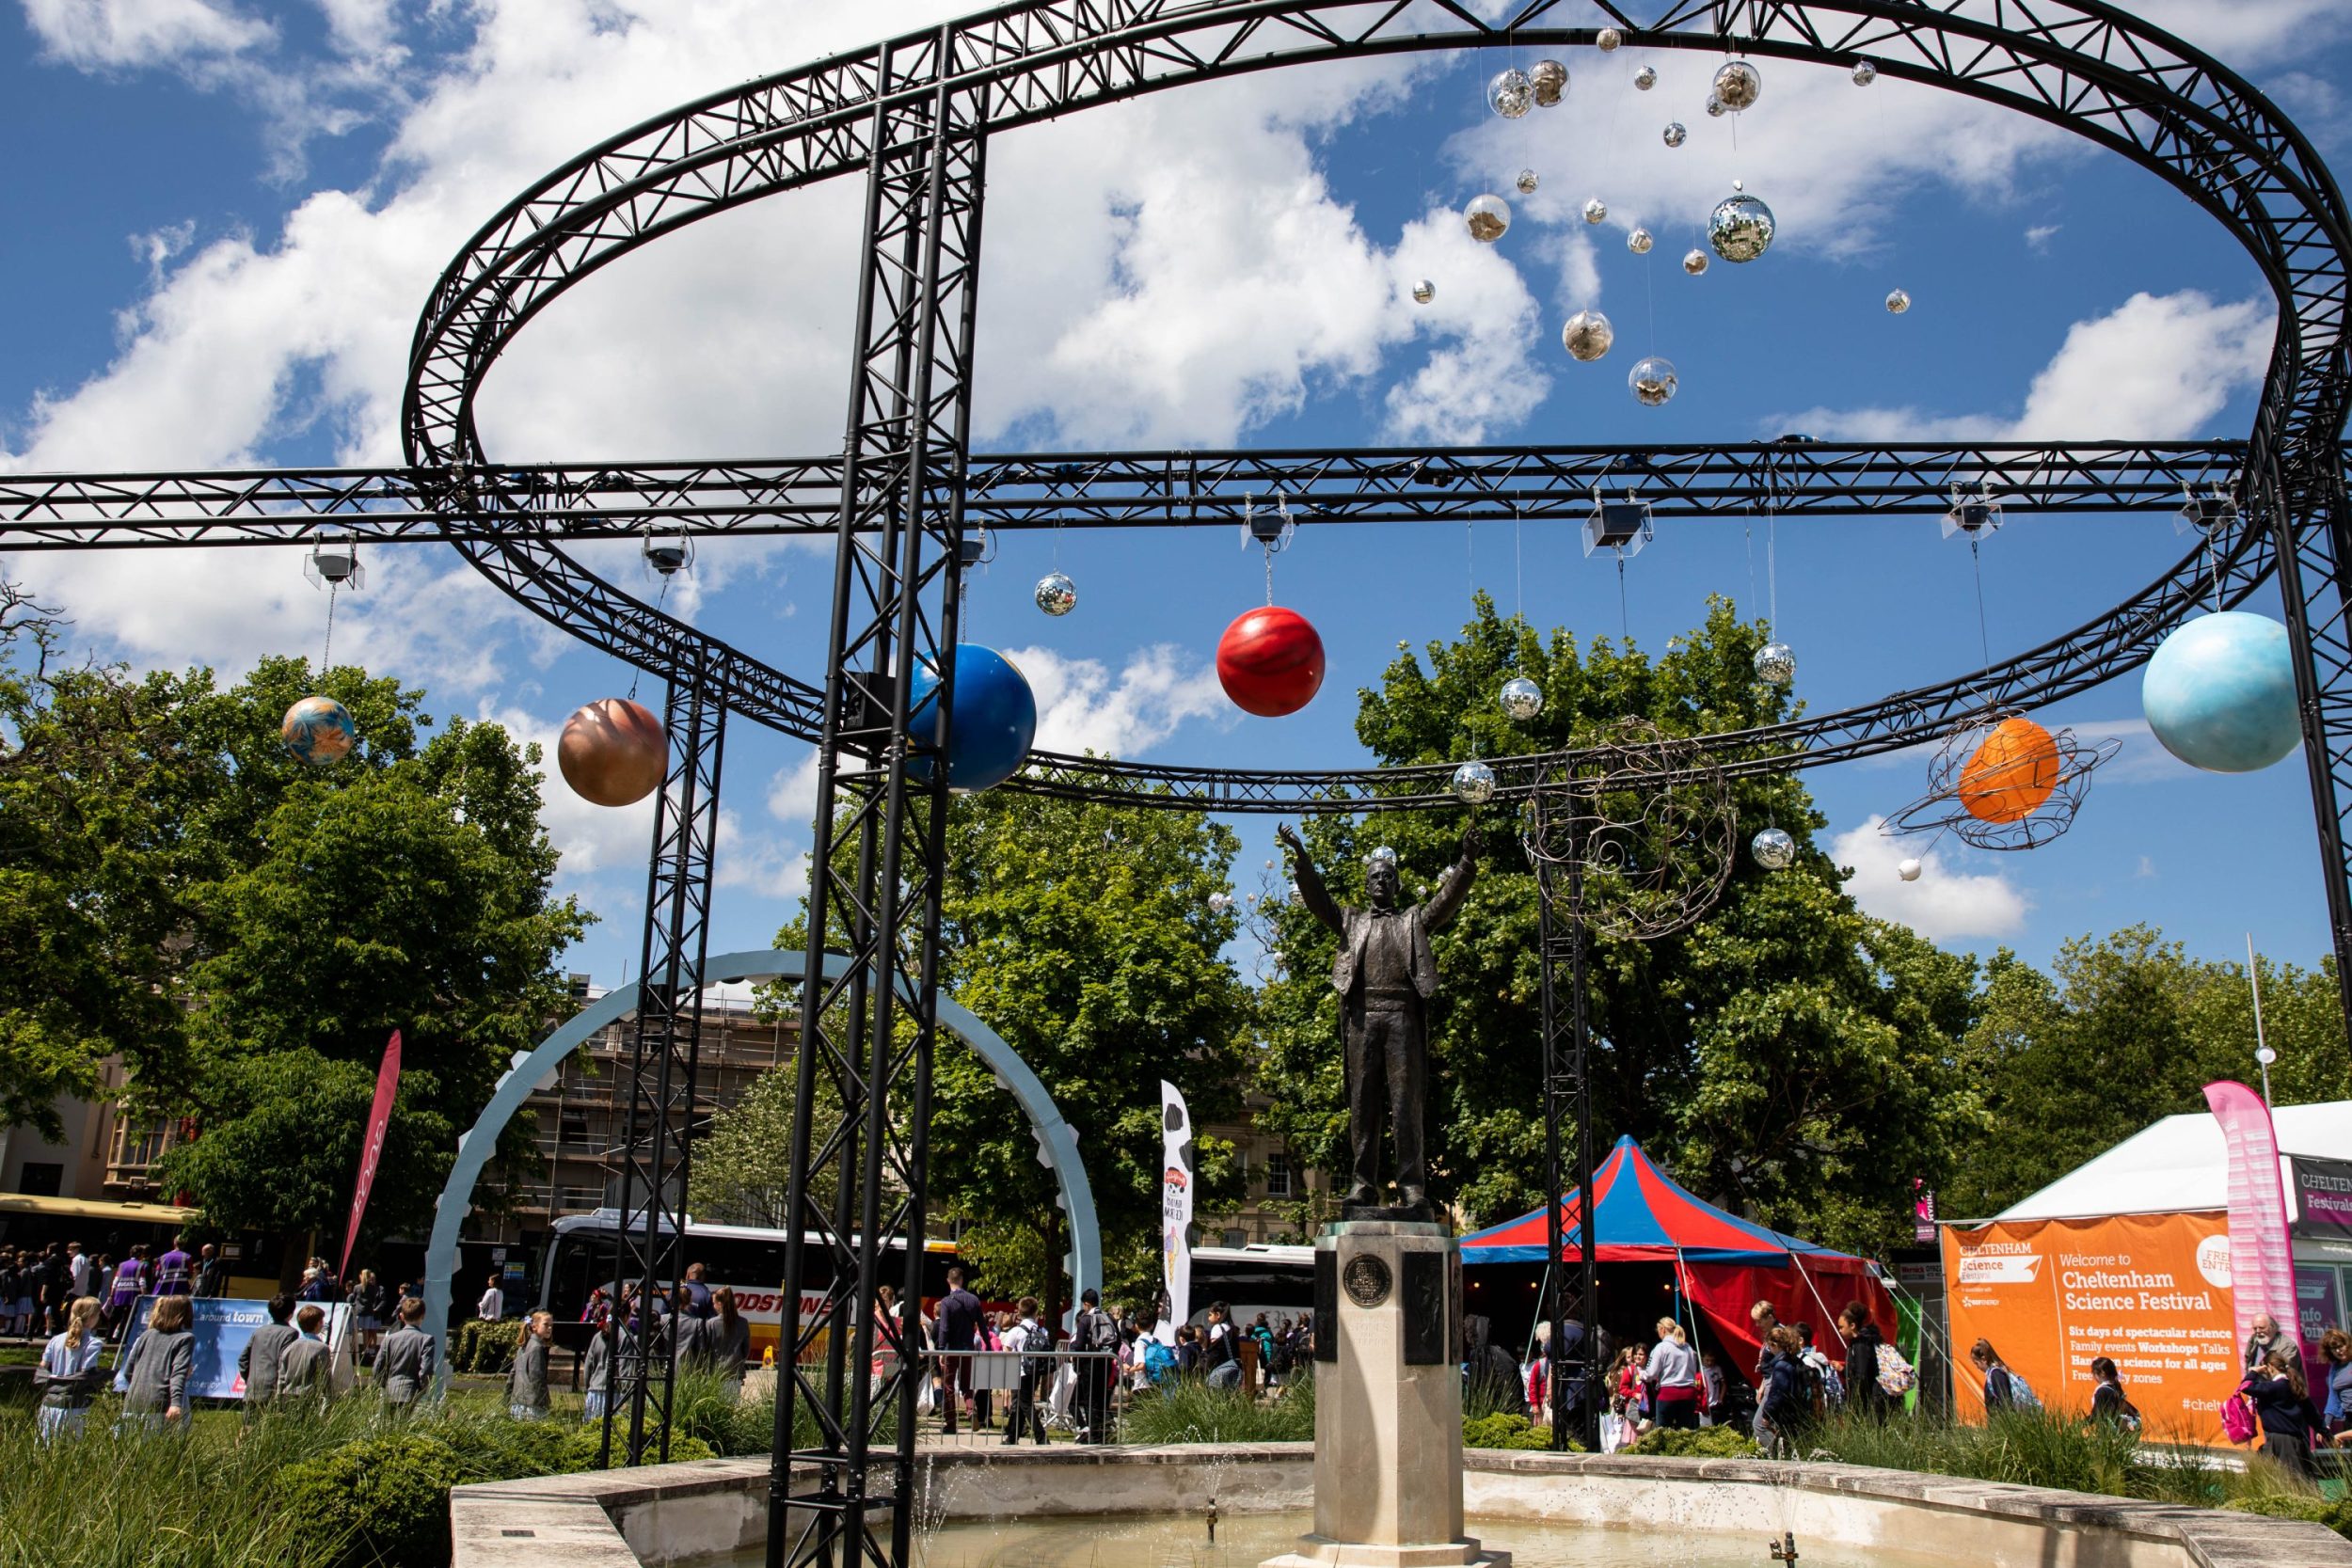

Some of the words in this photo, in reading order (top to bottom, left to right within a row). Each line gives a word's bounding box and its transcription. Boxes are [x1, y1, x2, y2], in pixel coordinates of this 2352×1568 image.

[1962, 1260, 2004, 1272] Science
[2059, 1253, 2115, 1267] Welcome
[2119, 1254, 2131, 1266] to
[2062, 1270, 2175, 1290] Cheltenham
[2066, 1291, 2135, 1310] Science
[2137, 1291, 2213, 1310] Festival
[232, 1309, 263, 1323] town
[2069, 1325, 2085, 1337] Six
[2087, 1325, 2111, 1339] days
[2112, 1326, 2124, 1338] of
[2125, 1327, 2187, 1340] spectacular
[2189, 1328, 2233, 1339] science
[2070, 1340, 2103, 1354] Family
[2105, 1343, 2137, 1353] events
[2137, 1342, 2200, 1355] Workshops
[2201, 1344, 2232, 1355] Talks
[2123, 1357, 2162, 1369] science
[2165, 1358, 2182, 1370] for
[2184, 1358, 2198, 1370] all
[2201, 1361, 2228, 1373] ages
[2072, 1370, 2093, 1381] Free
[2133, 1374, 2163, 1385] zones
